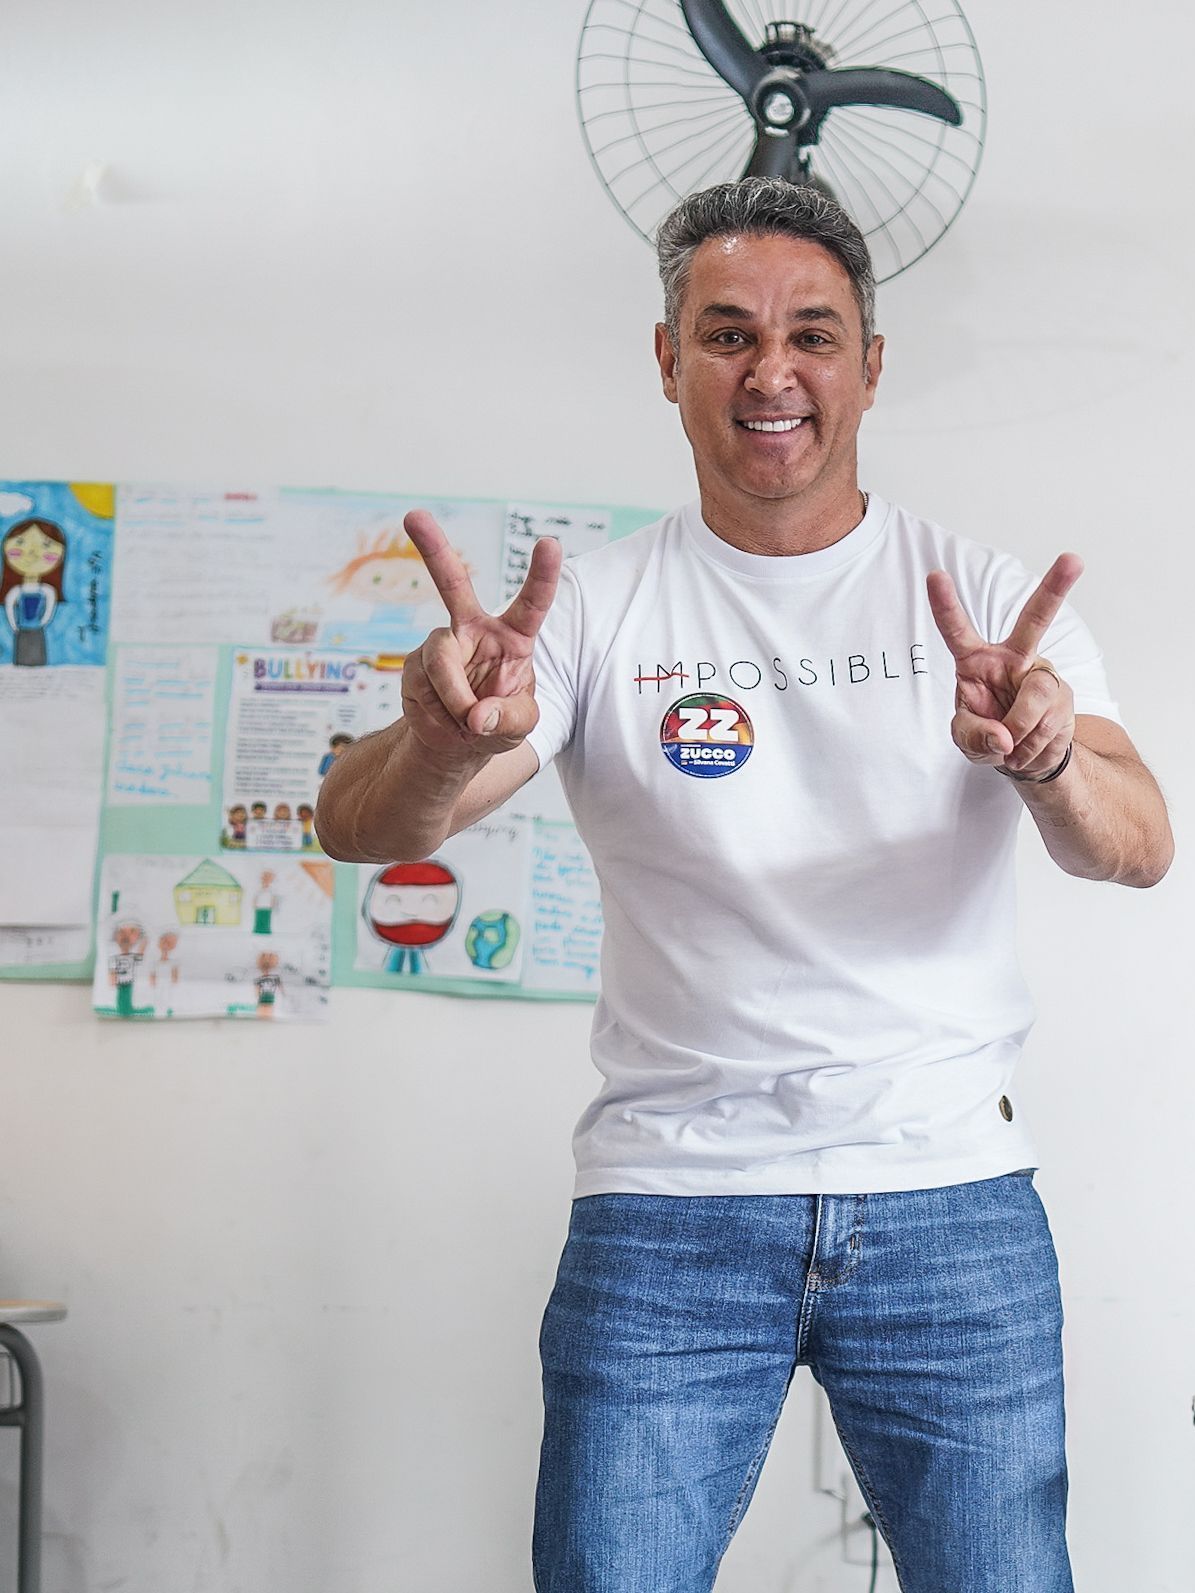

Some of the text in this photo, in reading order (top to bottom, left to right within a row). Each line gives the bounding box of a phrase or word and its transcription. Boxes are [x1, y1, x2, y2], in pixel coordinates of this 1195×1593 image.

[254, 657, 357, 681] BULLYING
[635, 643, 929, 695] IMPOSSIBLE
[677, 707, 741, 742] 22
[680, 748, 736, 761] ZUCCO
